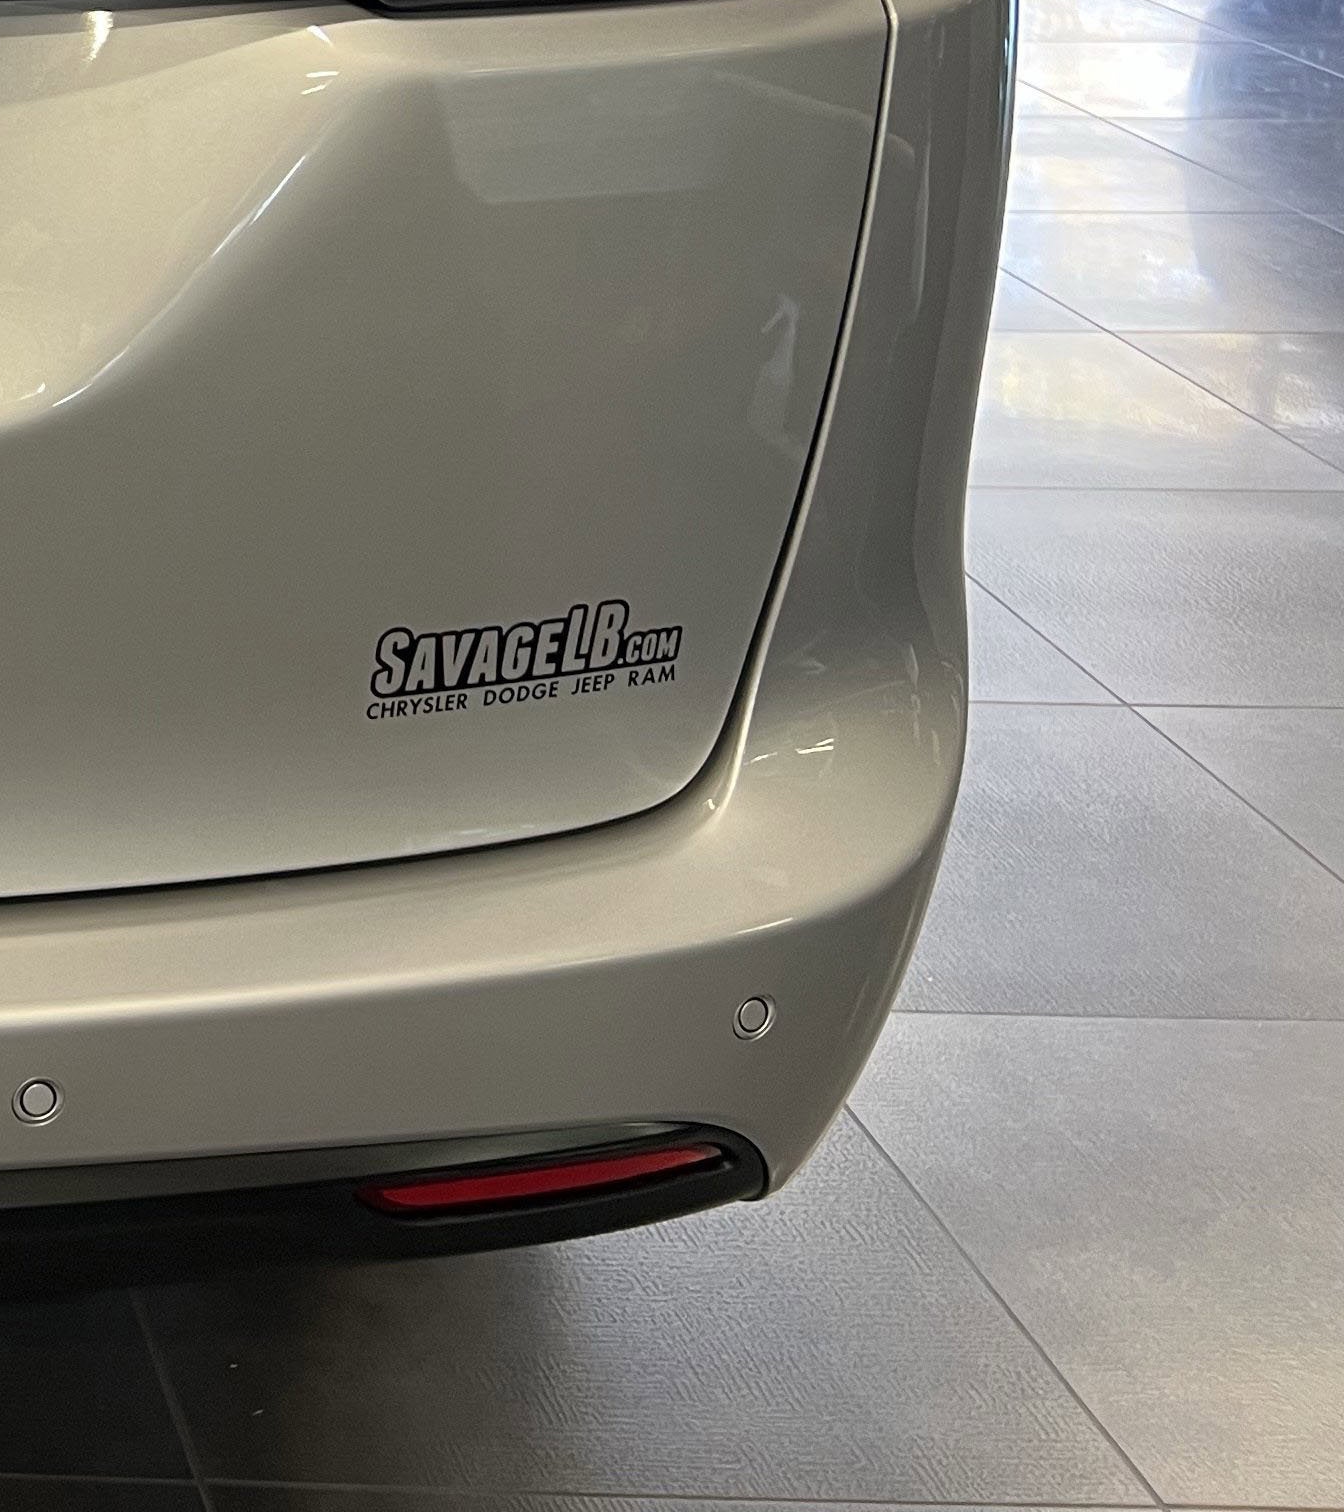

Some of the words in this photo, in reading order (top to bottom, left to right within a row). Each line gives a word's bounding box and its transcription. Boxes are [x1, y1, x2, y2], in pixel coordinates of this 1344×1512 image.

[366, 692, 468, 720] CHRYSLER
[482, 680, 559, 707] DODGE
[570, 673, 616, 696] JEEP
[627, 665, 676, 688] RAM
